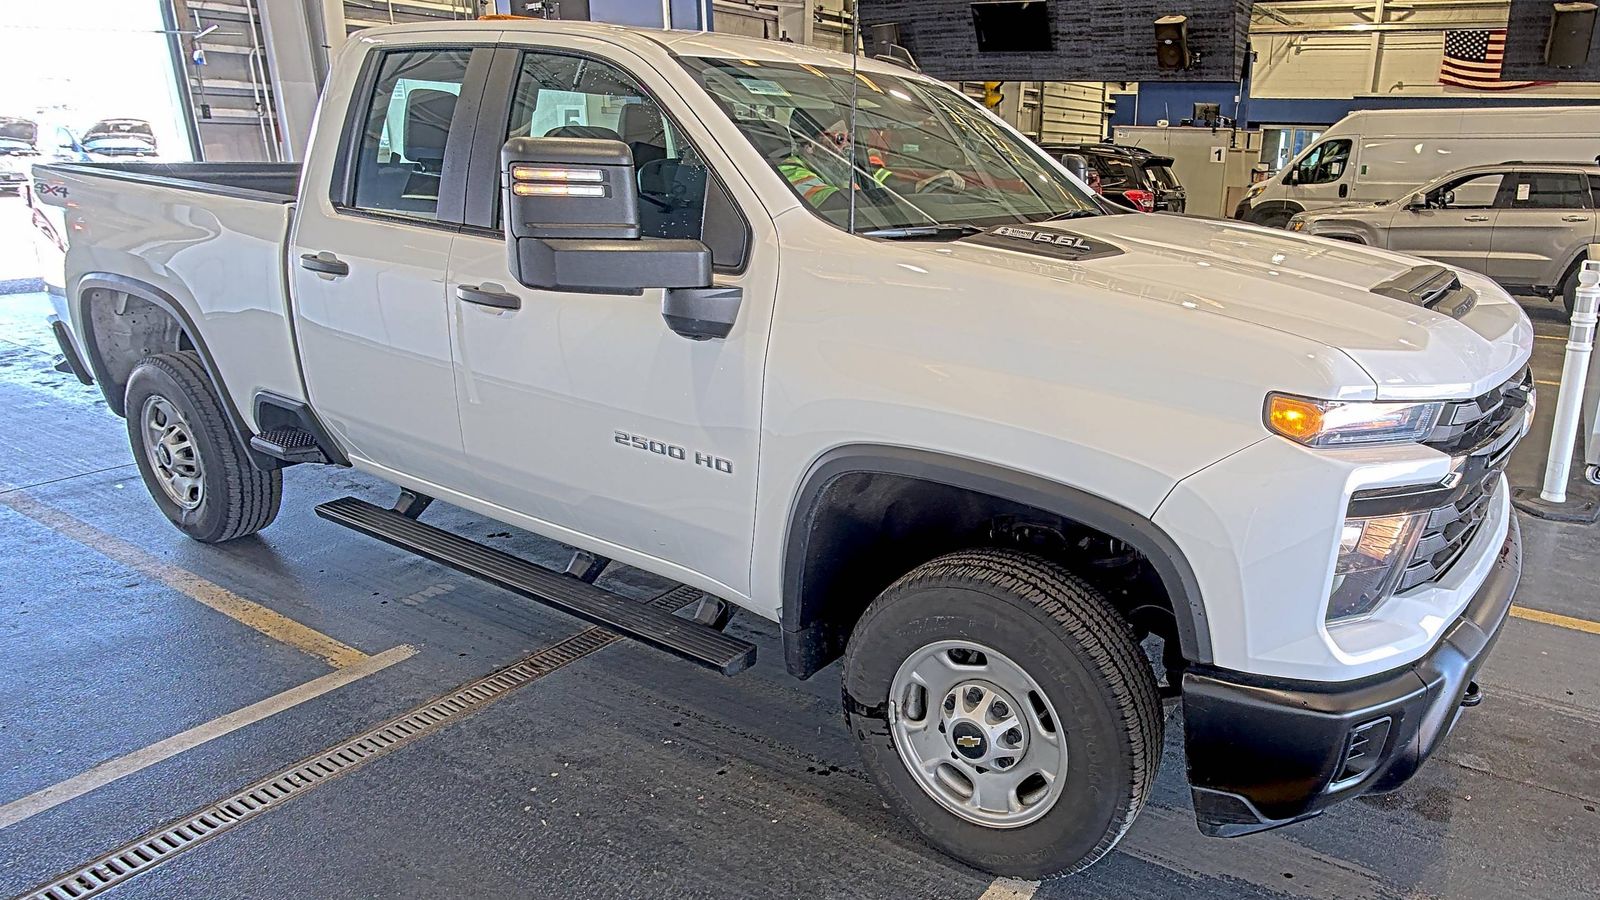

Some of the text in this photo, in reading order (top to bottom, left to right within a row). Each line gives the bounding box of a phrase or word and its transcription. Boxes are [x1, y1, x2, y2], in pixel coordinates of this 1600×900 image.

[1214, 149, 1222, 161] 1
[1034, 232, 1090, 250] 6.6L
[614, 430, 733, 474] 2500 HD
